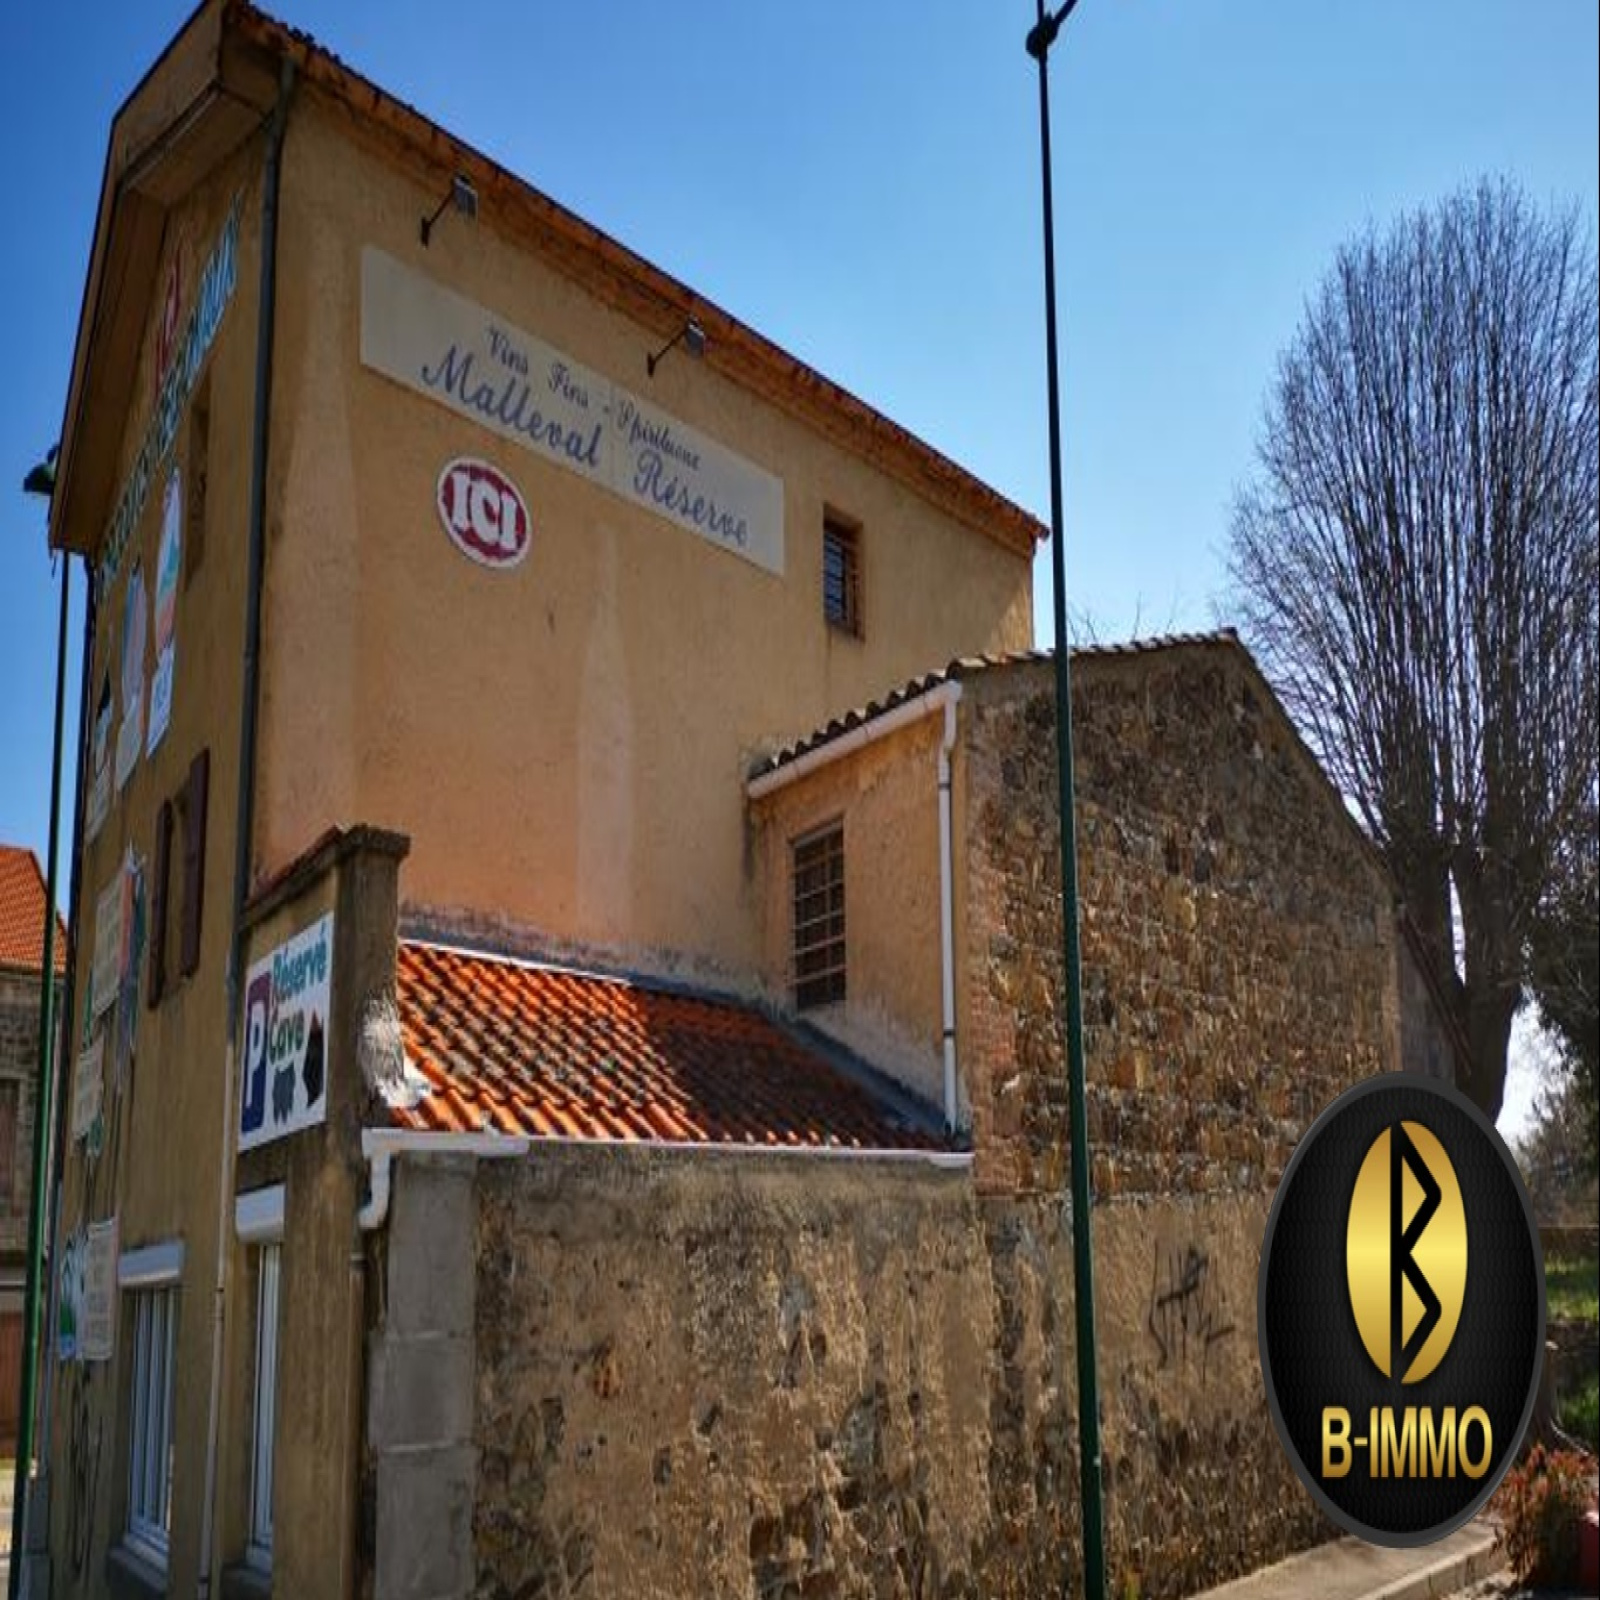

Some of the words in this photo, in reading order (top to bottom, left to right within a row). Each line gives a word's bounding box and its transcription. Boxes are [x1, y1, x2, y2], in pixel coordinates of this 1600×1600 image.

[421, 345, 602, 467] Malleval
[451, 468, 519, 549] ICI
[246, 1000, 265, 1108] P
